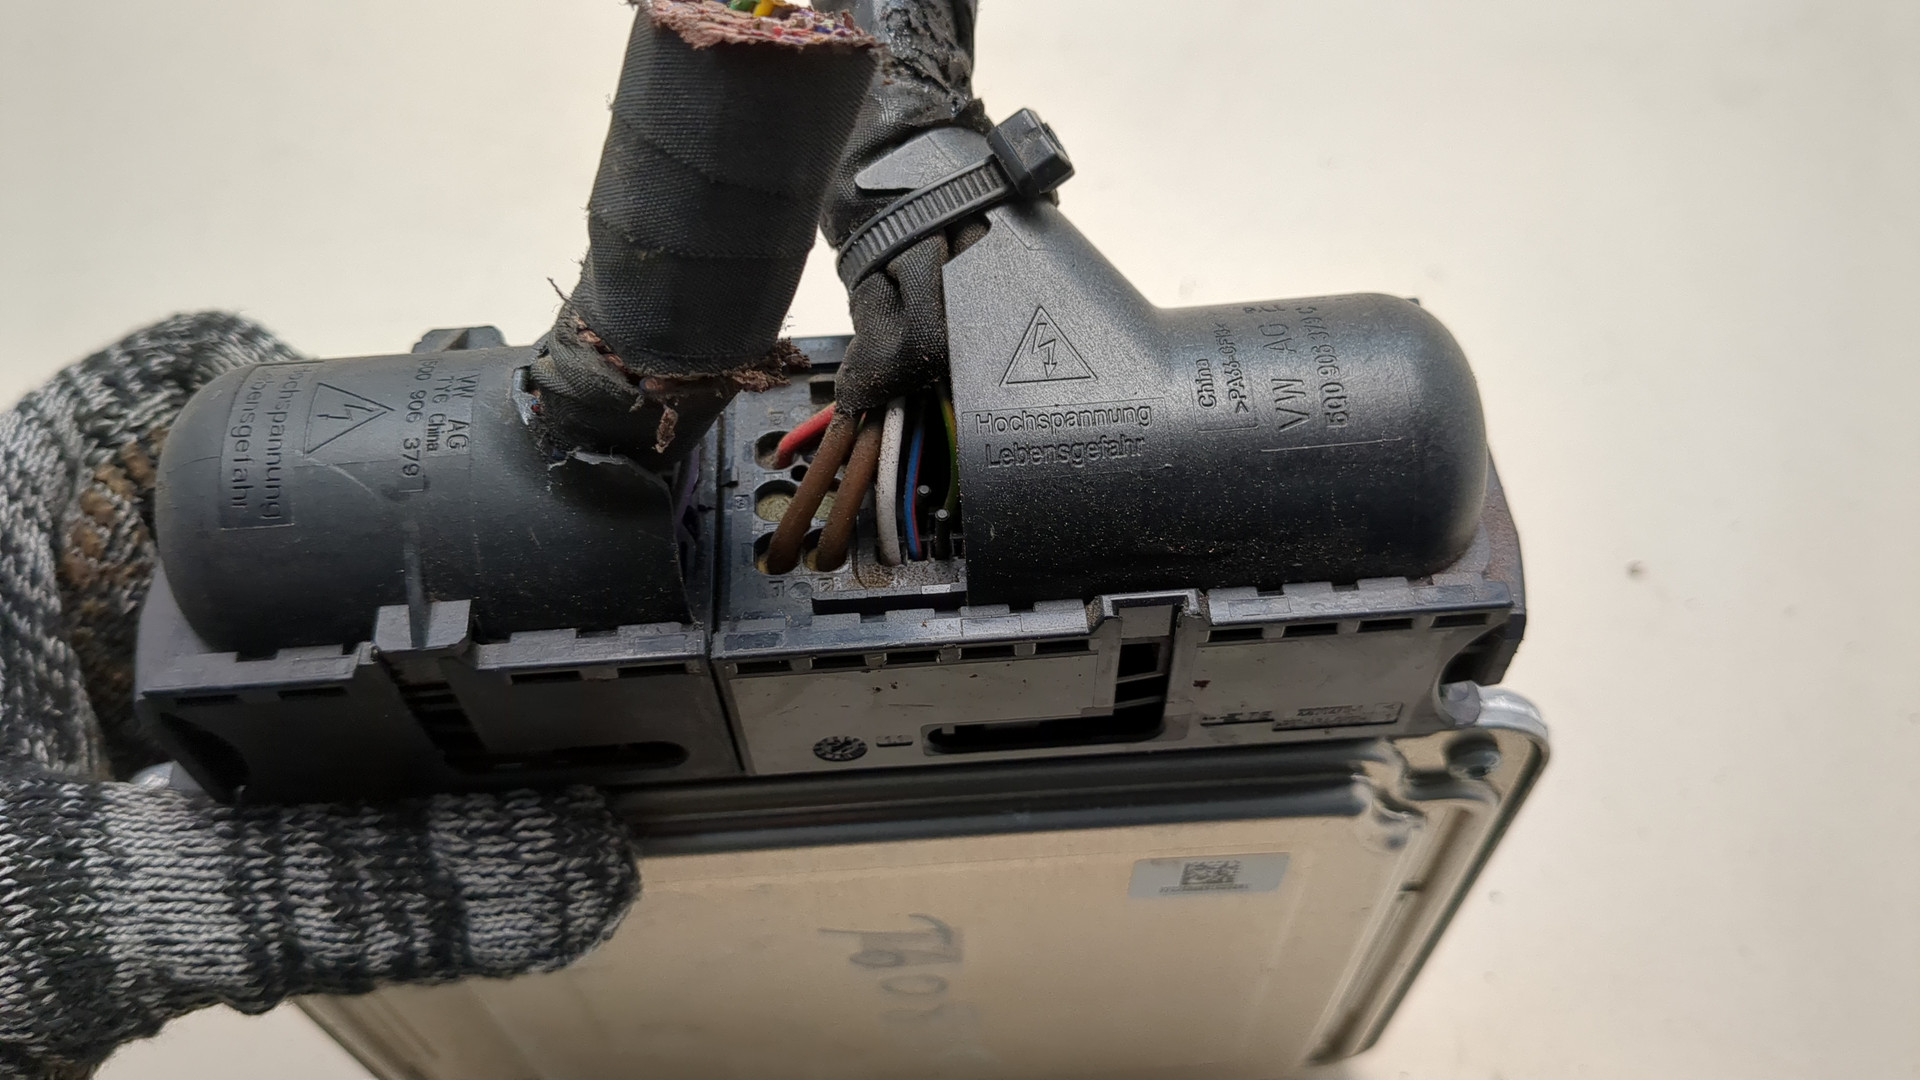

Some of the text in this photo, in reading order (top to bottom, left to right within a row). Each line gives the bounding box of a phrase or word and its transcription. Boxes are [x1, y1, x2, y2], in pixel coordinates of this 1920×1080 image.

[1258, 323, 1298, 354] AG
[1195, 358, 1217, 410] China
[405, 389, 428, 424] 906
[446, 373, 480, 451] VW AG
[975, 405, 1153, 436] Hochspannung
[1271, 378, 1310, 433] VW
[426, 412, 447, 453] China
[984, 433, 1146, 469] Lebensgefahr
[402, 437, 421, 478] 379
